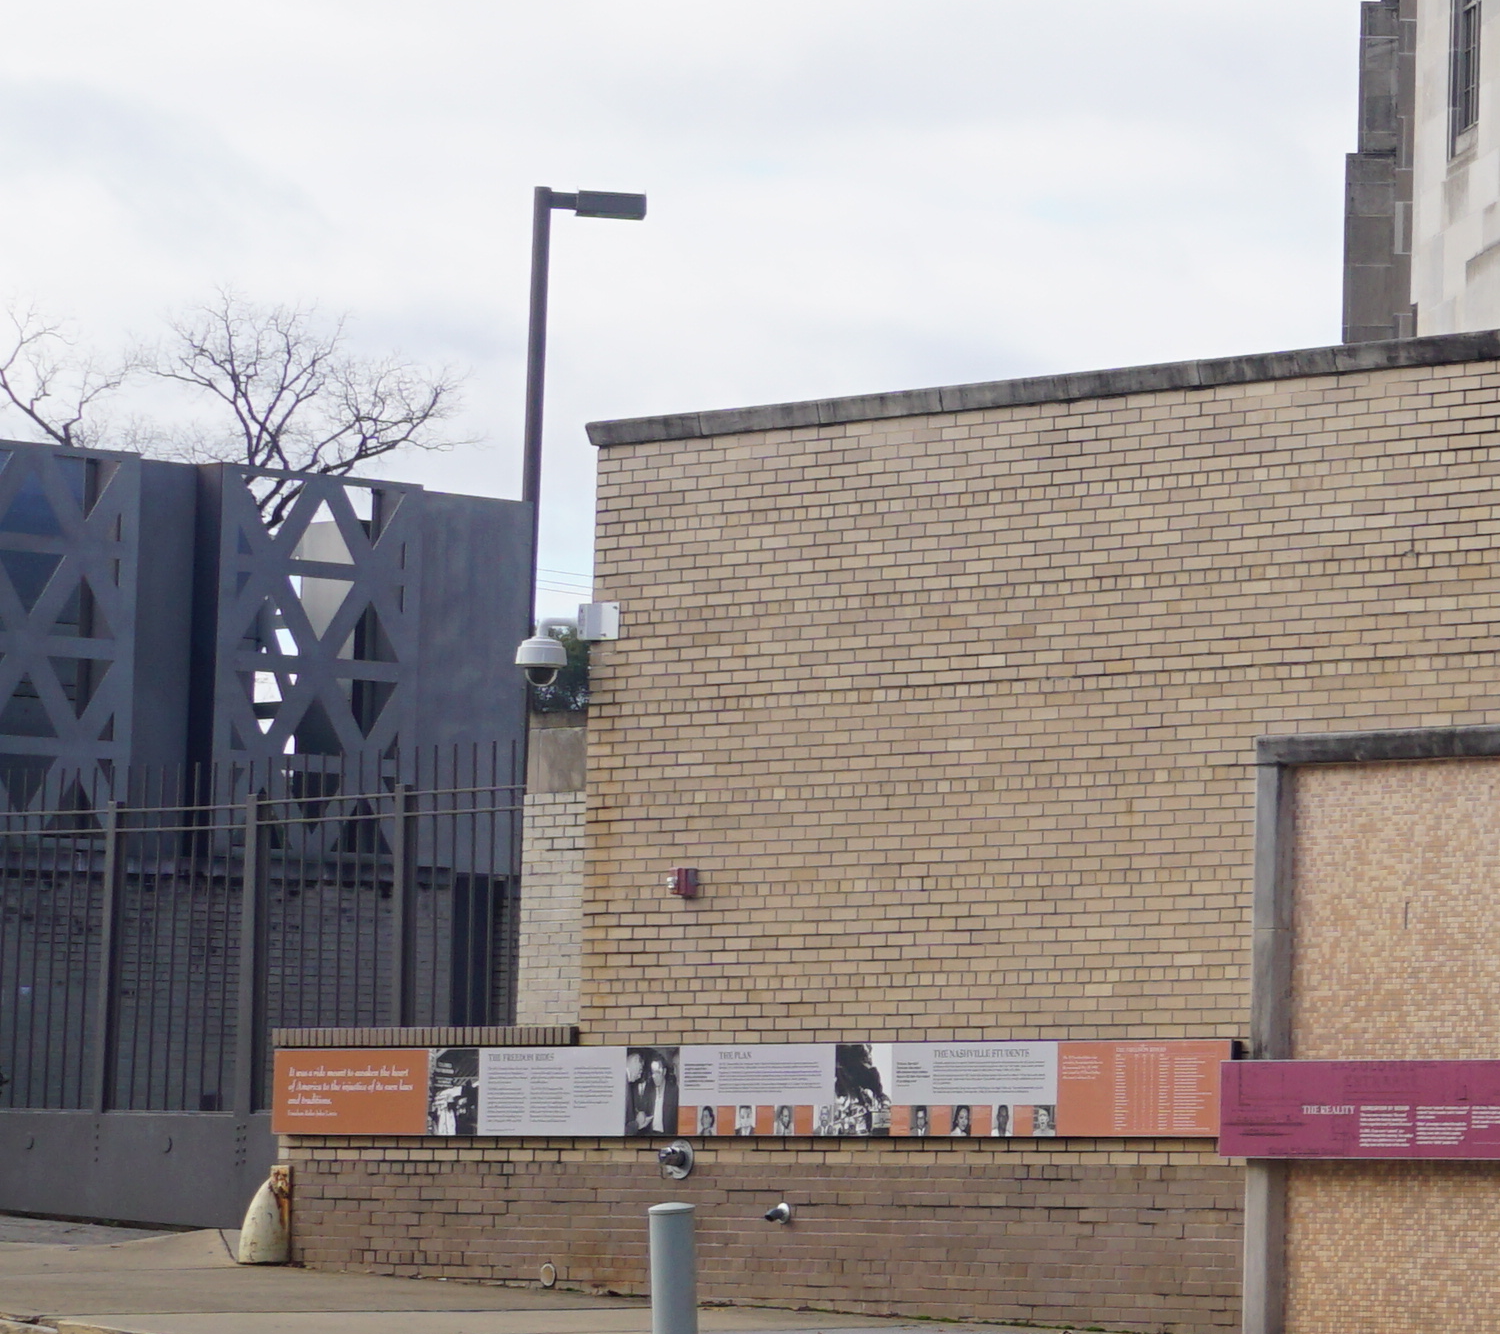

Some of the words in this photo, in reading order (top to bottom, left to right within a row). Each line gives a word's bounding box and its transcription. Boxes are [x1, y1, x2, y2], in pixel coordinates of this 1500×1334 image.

[488, 1053, 501, 1063] THE
[502, 1053, 534, 1063] FREEDOM
[535, 1053, 554, 1063] RIDES
[719, 1051, 732, 1060] THE
[733, 1051, 752, 1060] PLAN
[934, 1049, 949, 1059] THE
[950, 1049, 990, 1059] NASHVILLE
[992, 1049, 1030, 1059] STUDENTS
[1302, 1105, 1320, 1115] THE
[1321, 1105, 1356, 1115] REALITY
